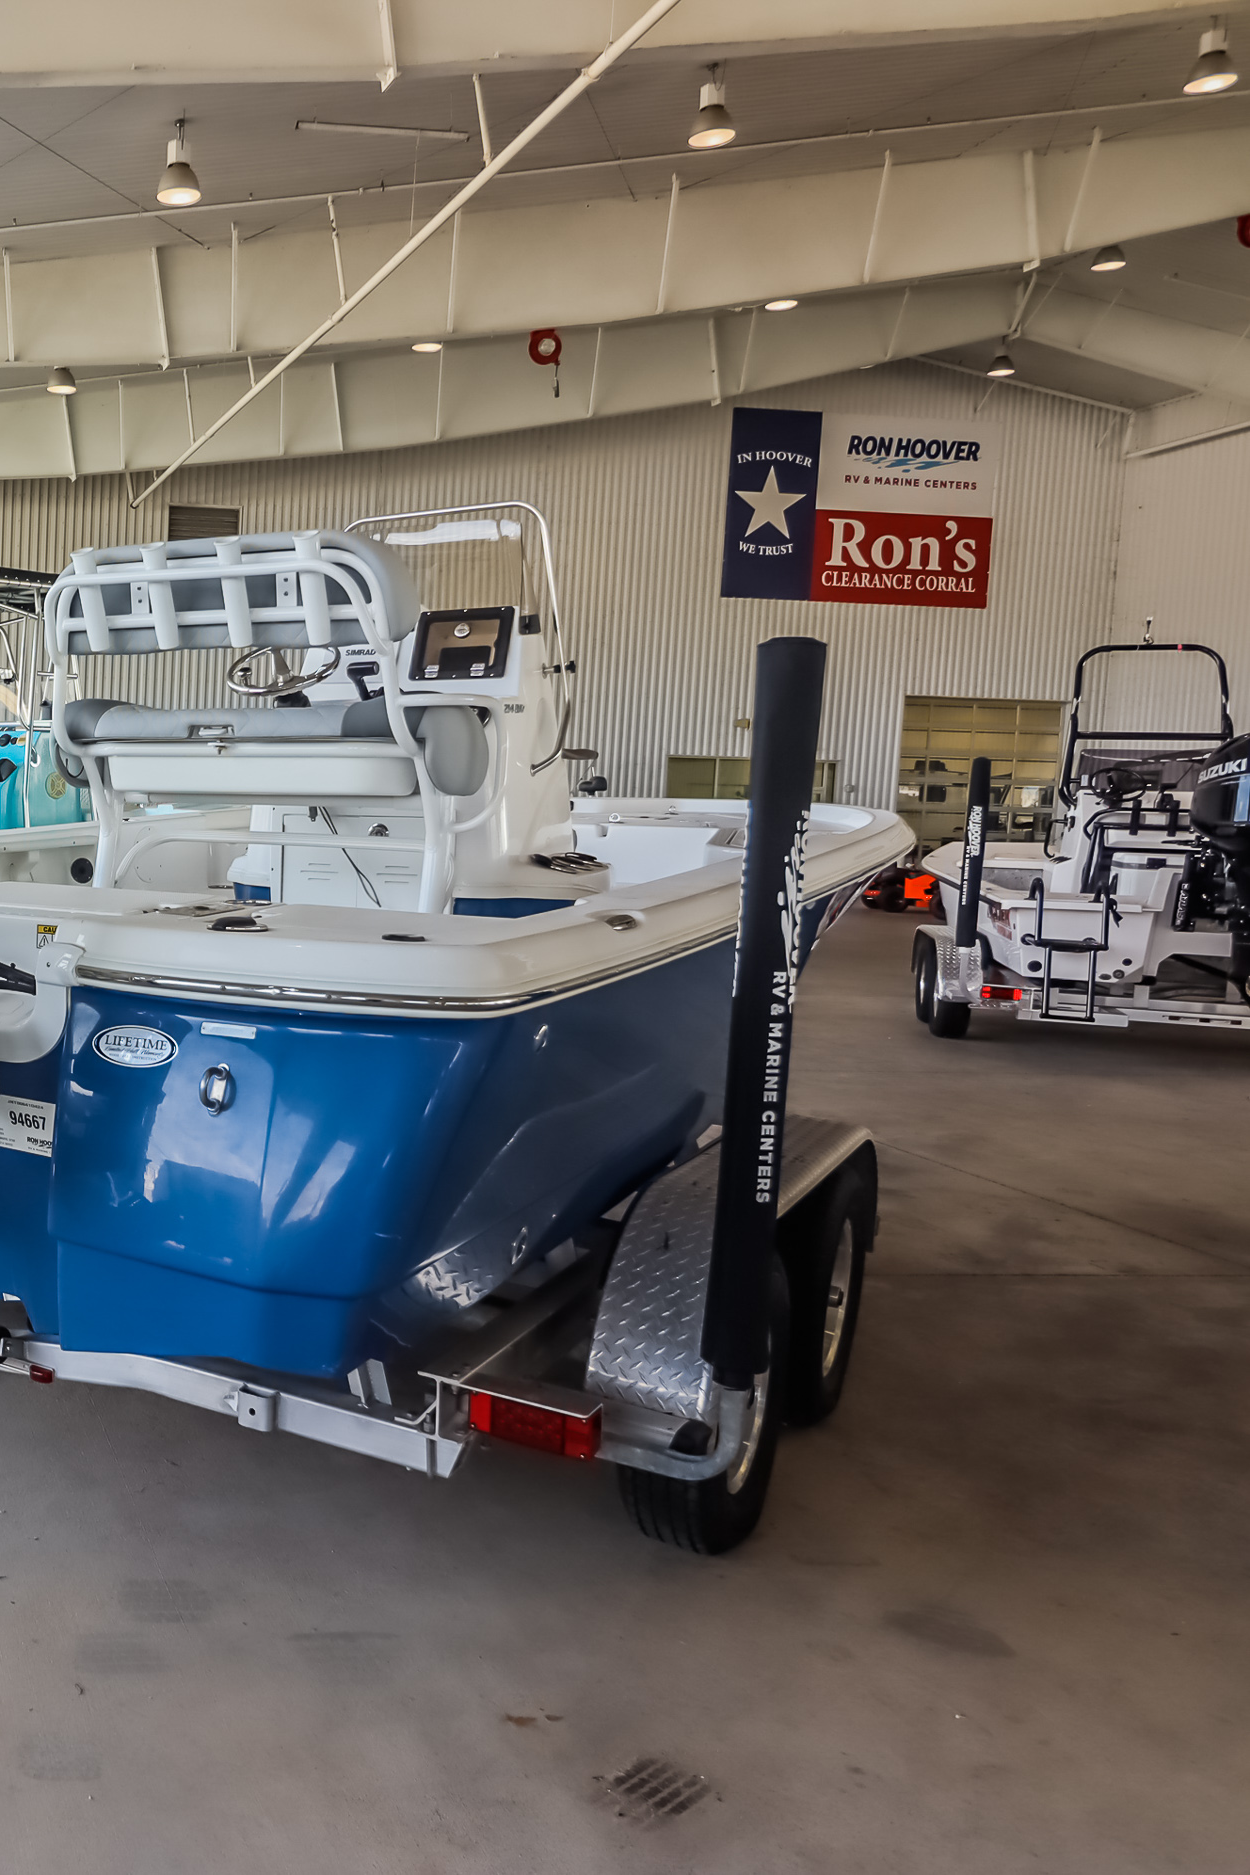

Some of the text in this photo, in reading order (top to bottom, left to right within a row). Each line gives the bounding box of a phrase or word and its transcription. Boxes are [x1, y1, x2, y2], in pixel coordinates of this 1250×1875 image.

[736, 450, 813, 468] IN HOOVER
[847, 434, 981, 462] RON HOOVER
[844, 474, 977, 491] RV & MARINE CENTERS
[738, 541, 794, 556] WE TRUST
[824, 517, 977, 573] Ron's
[821, 570, 976, 593] CLEARANCE CORRAL
[1197, 757, 1248, 784] SUZUKI
[969, 805, 983, 857] RON HOOVER
[104, 1034, 168, 1051] LIFETIME
[755, 971, 788, 1204] RV & MARINE CENTERS
[9, 1110, 46, 1131] 94667
